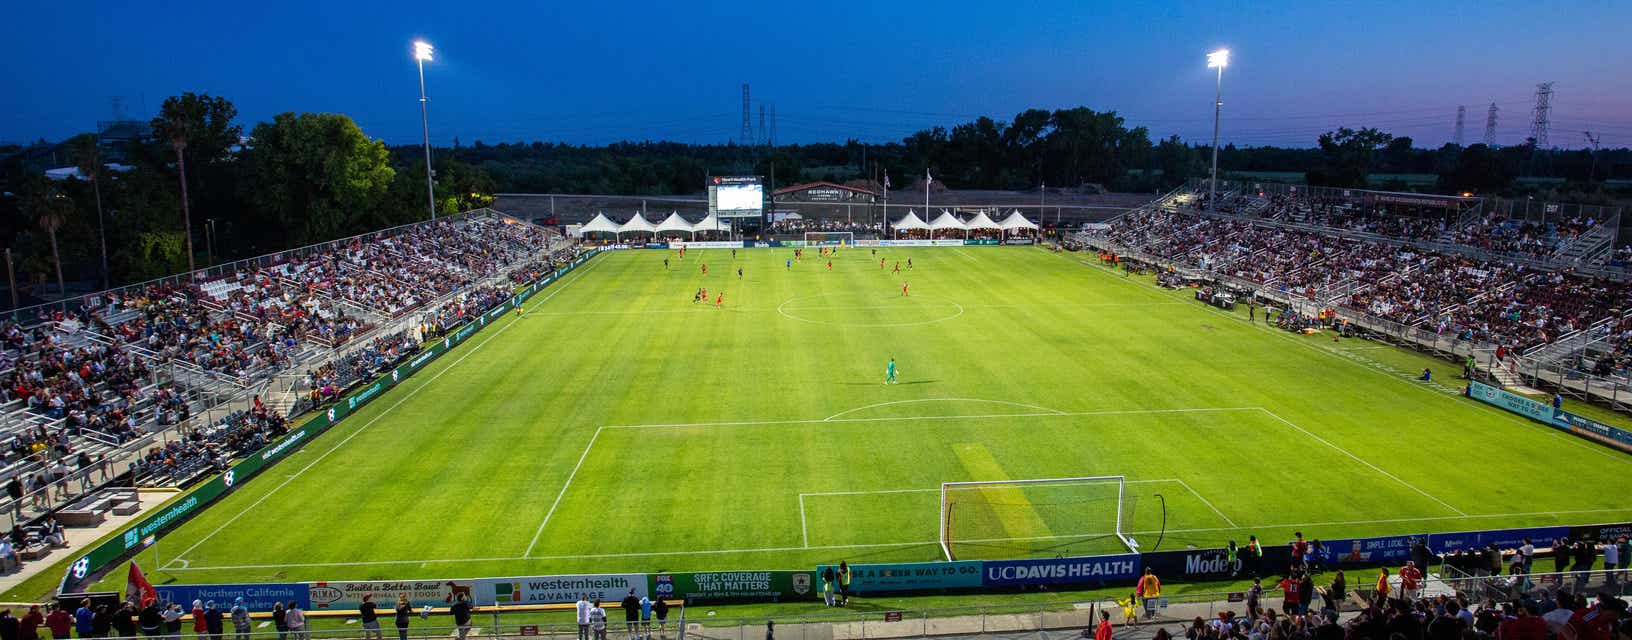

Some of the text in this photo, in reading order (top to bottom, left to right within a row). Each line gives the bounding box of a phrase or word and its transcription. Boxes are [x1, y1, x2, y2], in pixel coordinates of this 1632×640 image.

[141, 496, 198, 536] westernhealth
[1068, 561, 1134, 577] HEALTH
[1186, 553, 1243, 575] Modeo
[915, 568, 938, 577] WAY
[942, 567, 955, 575] TO
[694, 572, 772, 583] SRFC COVERAGE
[345, 583, 373, 592] Build
[382, 582, 412, 591] Better
[414, 582, 441, 590] Bowl
[528, 577, 629, 590] westernhealth
[656, 583, 673, 593] 40
[698, 581, 769, 591] THAT MATTERS
[198, 588, 295, 598] Northern California
[414, 590, 441, 598] FOODS
